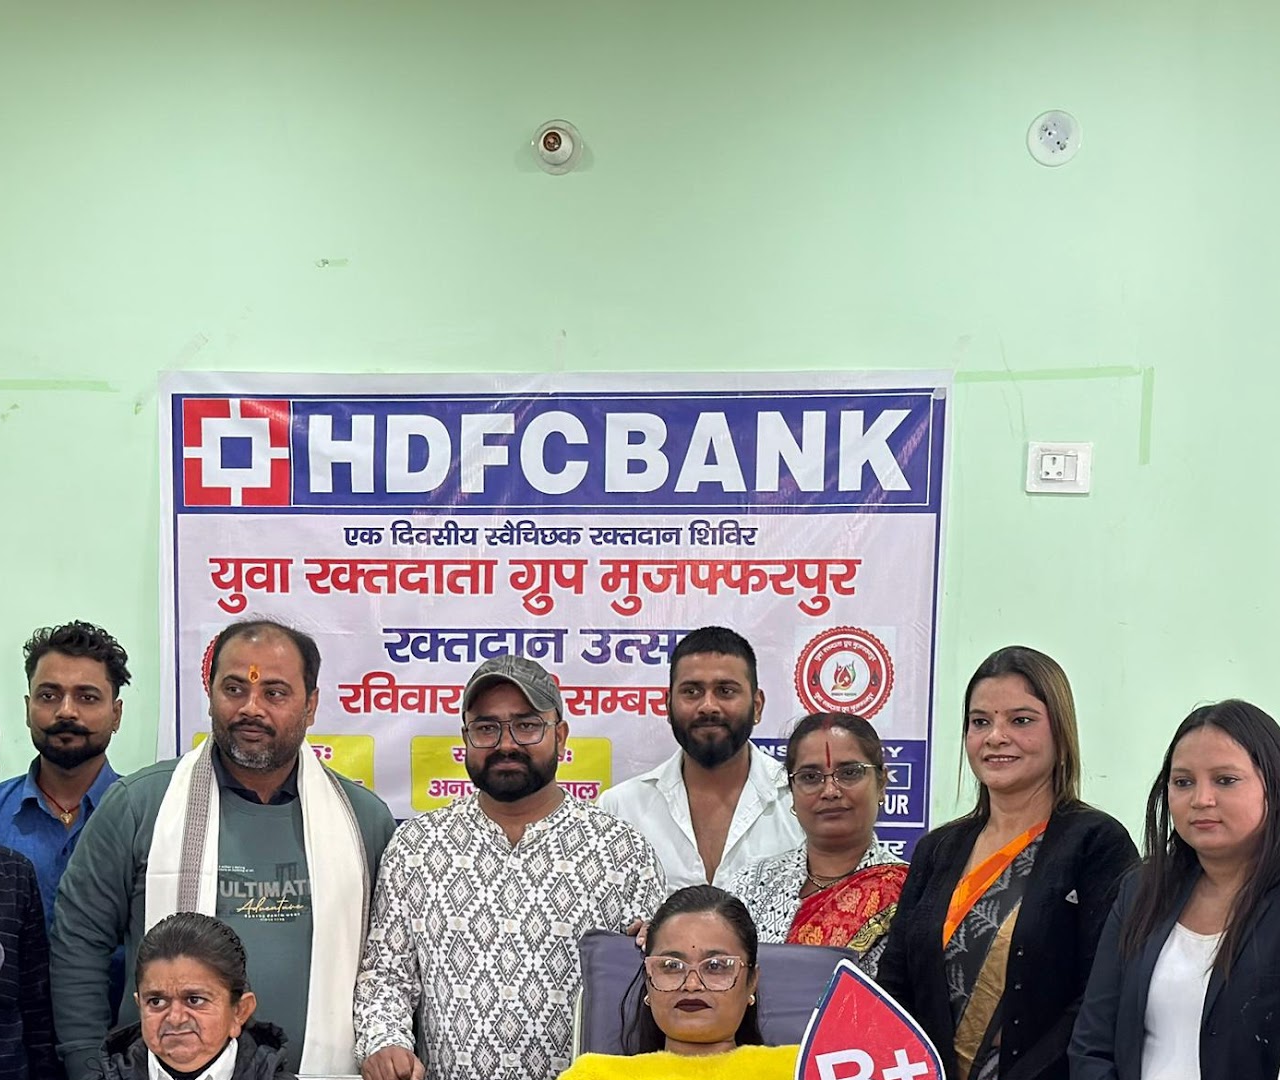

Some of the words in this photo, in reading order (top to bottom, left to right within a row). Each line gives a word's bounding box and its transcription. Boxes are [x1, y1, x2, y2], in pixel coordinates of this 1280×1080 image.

[307, 410, 590, 495] HDFC
[604, 409, 913, 494] BANK
[344, 526, 384, 546] एक
[390, 520, 478, 546] दिवसीय
[589, 527, 682, 546] रक्तदान
[688, 520, 759, 546] शिविर
[208, 558, 294, 614] युवा
[304, 559, 498, 594] रक्तदाता
[509, 559, 588, 616] ग्रुप
[600, 559, 862, 617] मुजफ्फरपुर
[382, 628, 568, 664] रक्तदान
[338, 672, 465, 715] रविवार
[220, 880, 311, 898] ULTIMAT
